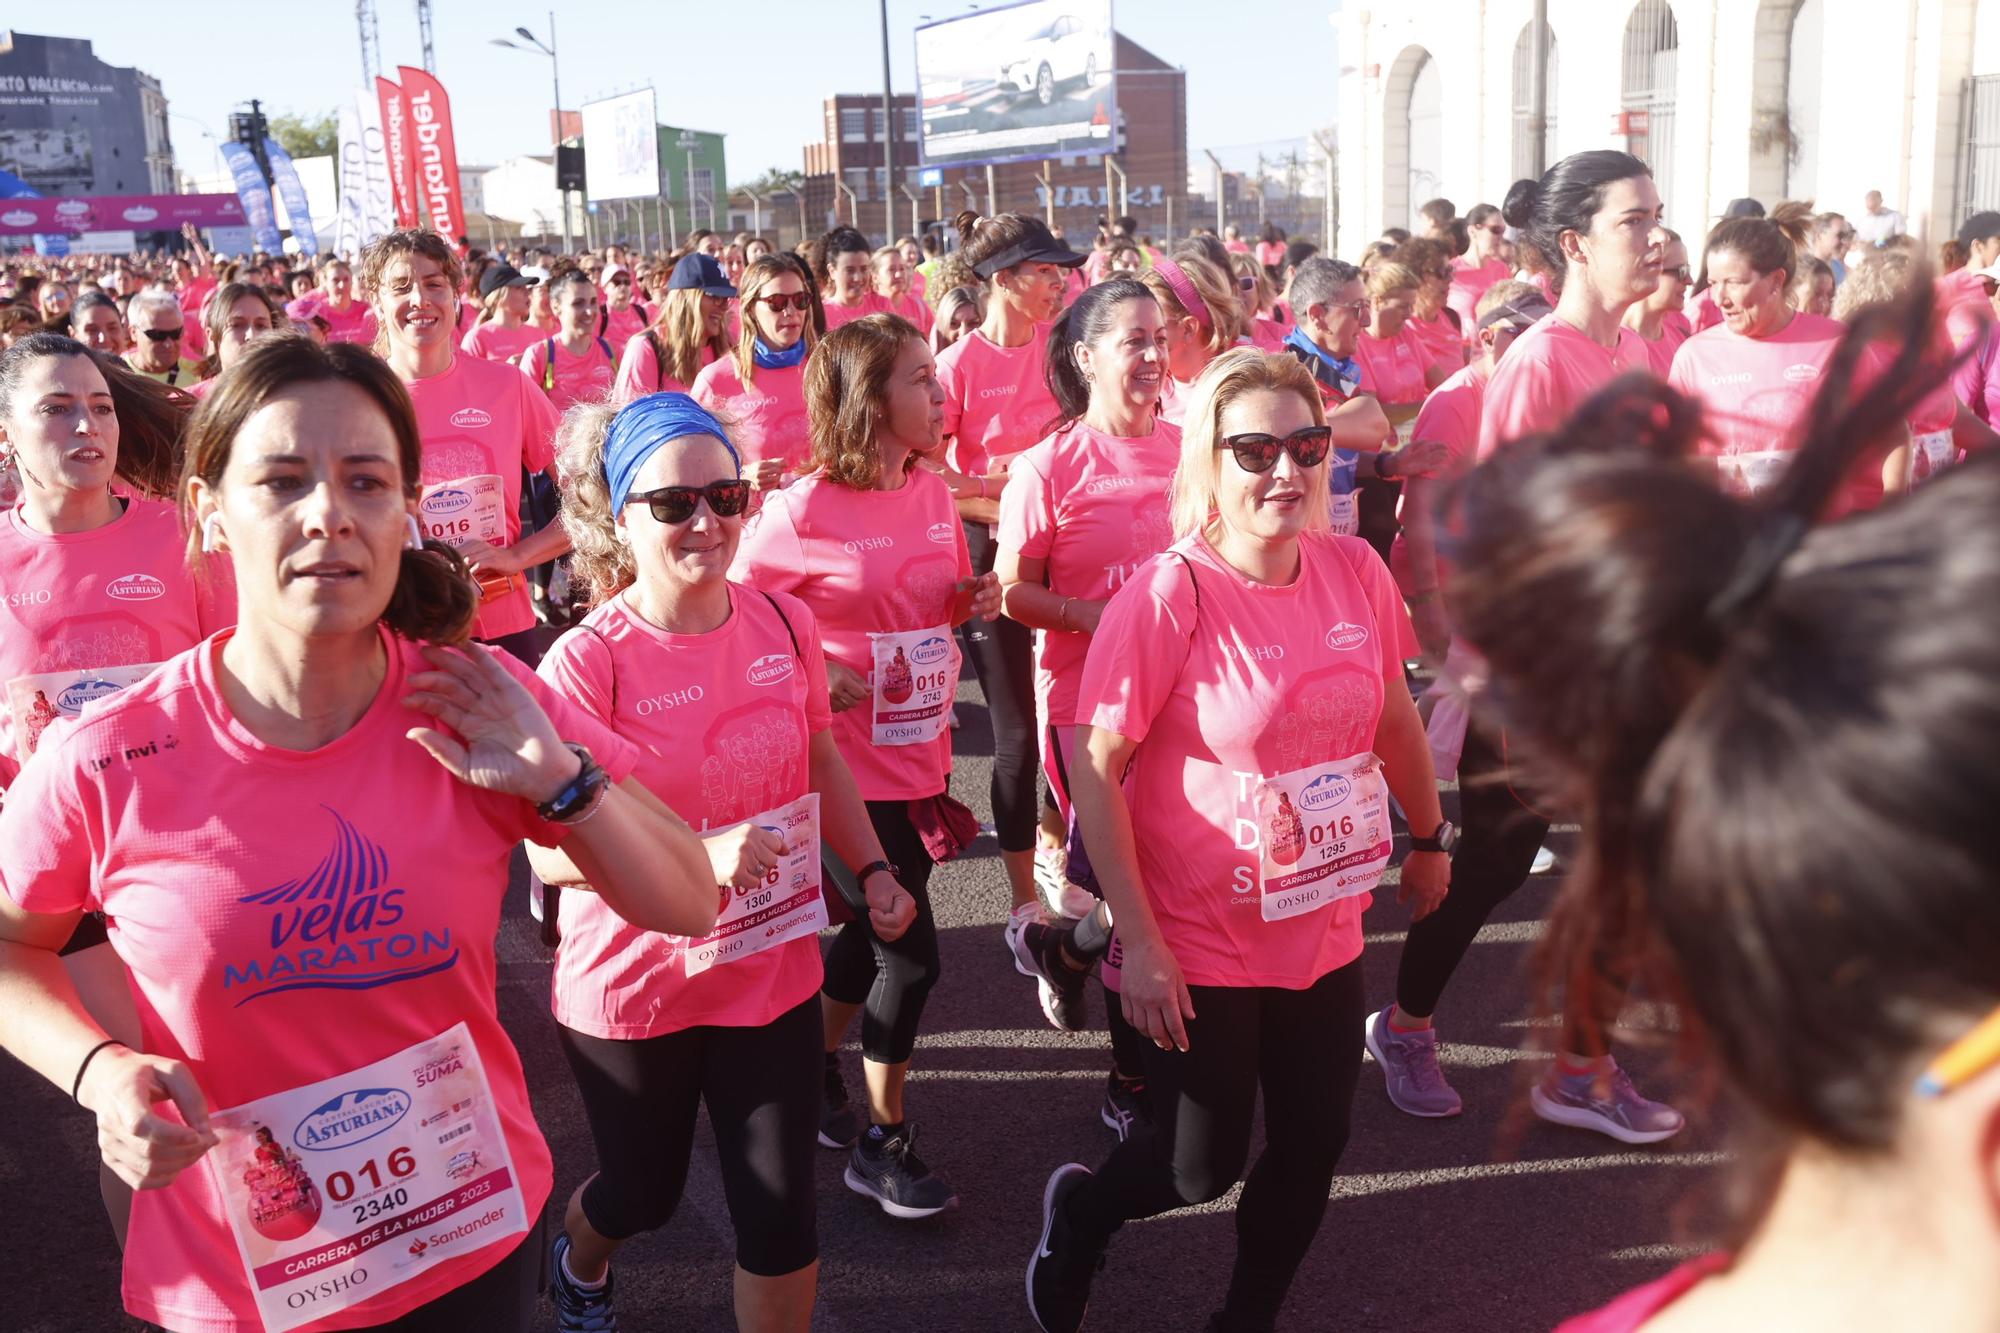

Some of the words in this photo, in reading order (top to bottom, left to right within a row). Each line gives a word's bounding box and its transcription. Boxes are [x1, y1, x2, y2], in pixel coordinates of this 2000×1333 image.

[980, 384, 1018, 399] OYSHO
[1085, 476, 1135, 496] OYSHO
[425, 498, 470, 511] ASTURIANA
[431, 518, 470, 537] 016
[844, 535, 894, 554] OYSHO
[111, 582, 162, 597] ASTURIANA
[914, 646, 947, 661] ASTURIANA
[1225, 644, 1284, 661] OSHO
[916, 670, 946, 691] 016
[636, 685, 704, 716] OYSHO
[922, 691, 941, 704] 2743
[889, 712, 921, 721] CARRERA
[885, 726, 922, 739] OYSHO
[91, 741, 158, 772] lunvi
[1304, 784, 1349, 807] ASTURIANA
[1309, 815, 1354, 845] 016
[1319, 841, 1347, 860] 1295
[1280, 870, 1318, 888] CARRERA
[1319, 866, 1329, 876] DE
[1330, 863, 1339, 872] LA
[1340, 854, 1365, 869] MUJER
[744, 890, 772, 911] 1300
[1277, 889, 1320, 910] OYSHO
[270, 887, 407, 950] velas
[743, 917, 756, 928] DE
[757, 913, 767, 922] LA
[768, 901, 792, 918] MUJER
[775, 910, 817, 934] Santander
[223, 926, 451, 988] MARATON
[698, 939, 744, 961] OYSHO
[416, 1060, 464, 1088] SUMA
[305, 1100, 405, 1146] ASTURIANA
[325, 1146, 416, 1202] 016
[352, 1187, 408, 1225] 2340
[284, 1241, 358, 1275] CARRERA
[361, 1228, 382, 1247] DE
[384, 1221, 404, 1236] LA
[407, 1197, 456, 1228] MUJER
[459, 1180, 491, 1204] 2023
[429, 1207, 505, 1248] Santander
[287, 1268, 368, 1309] OYSHO
